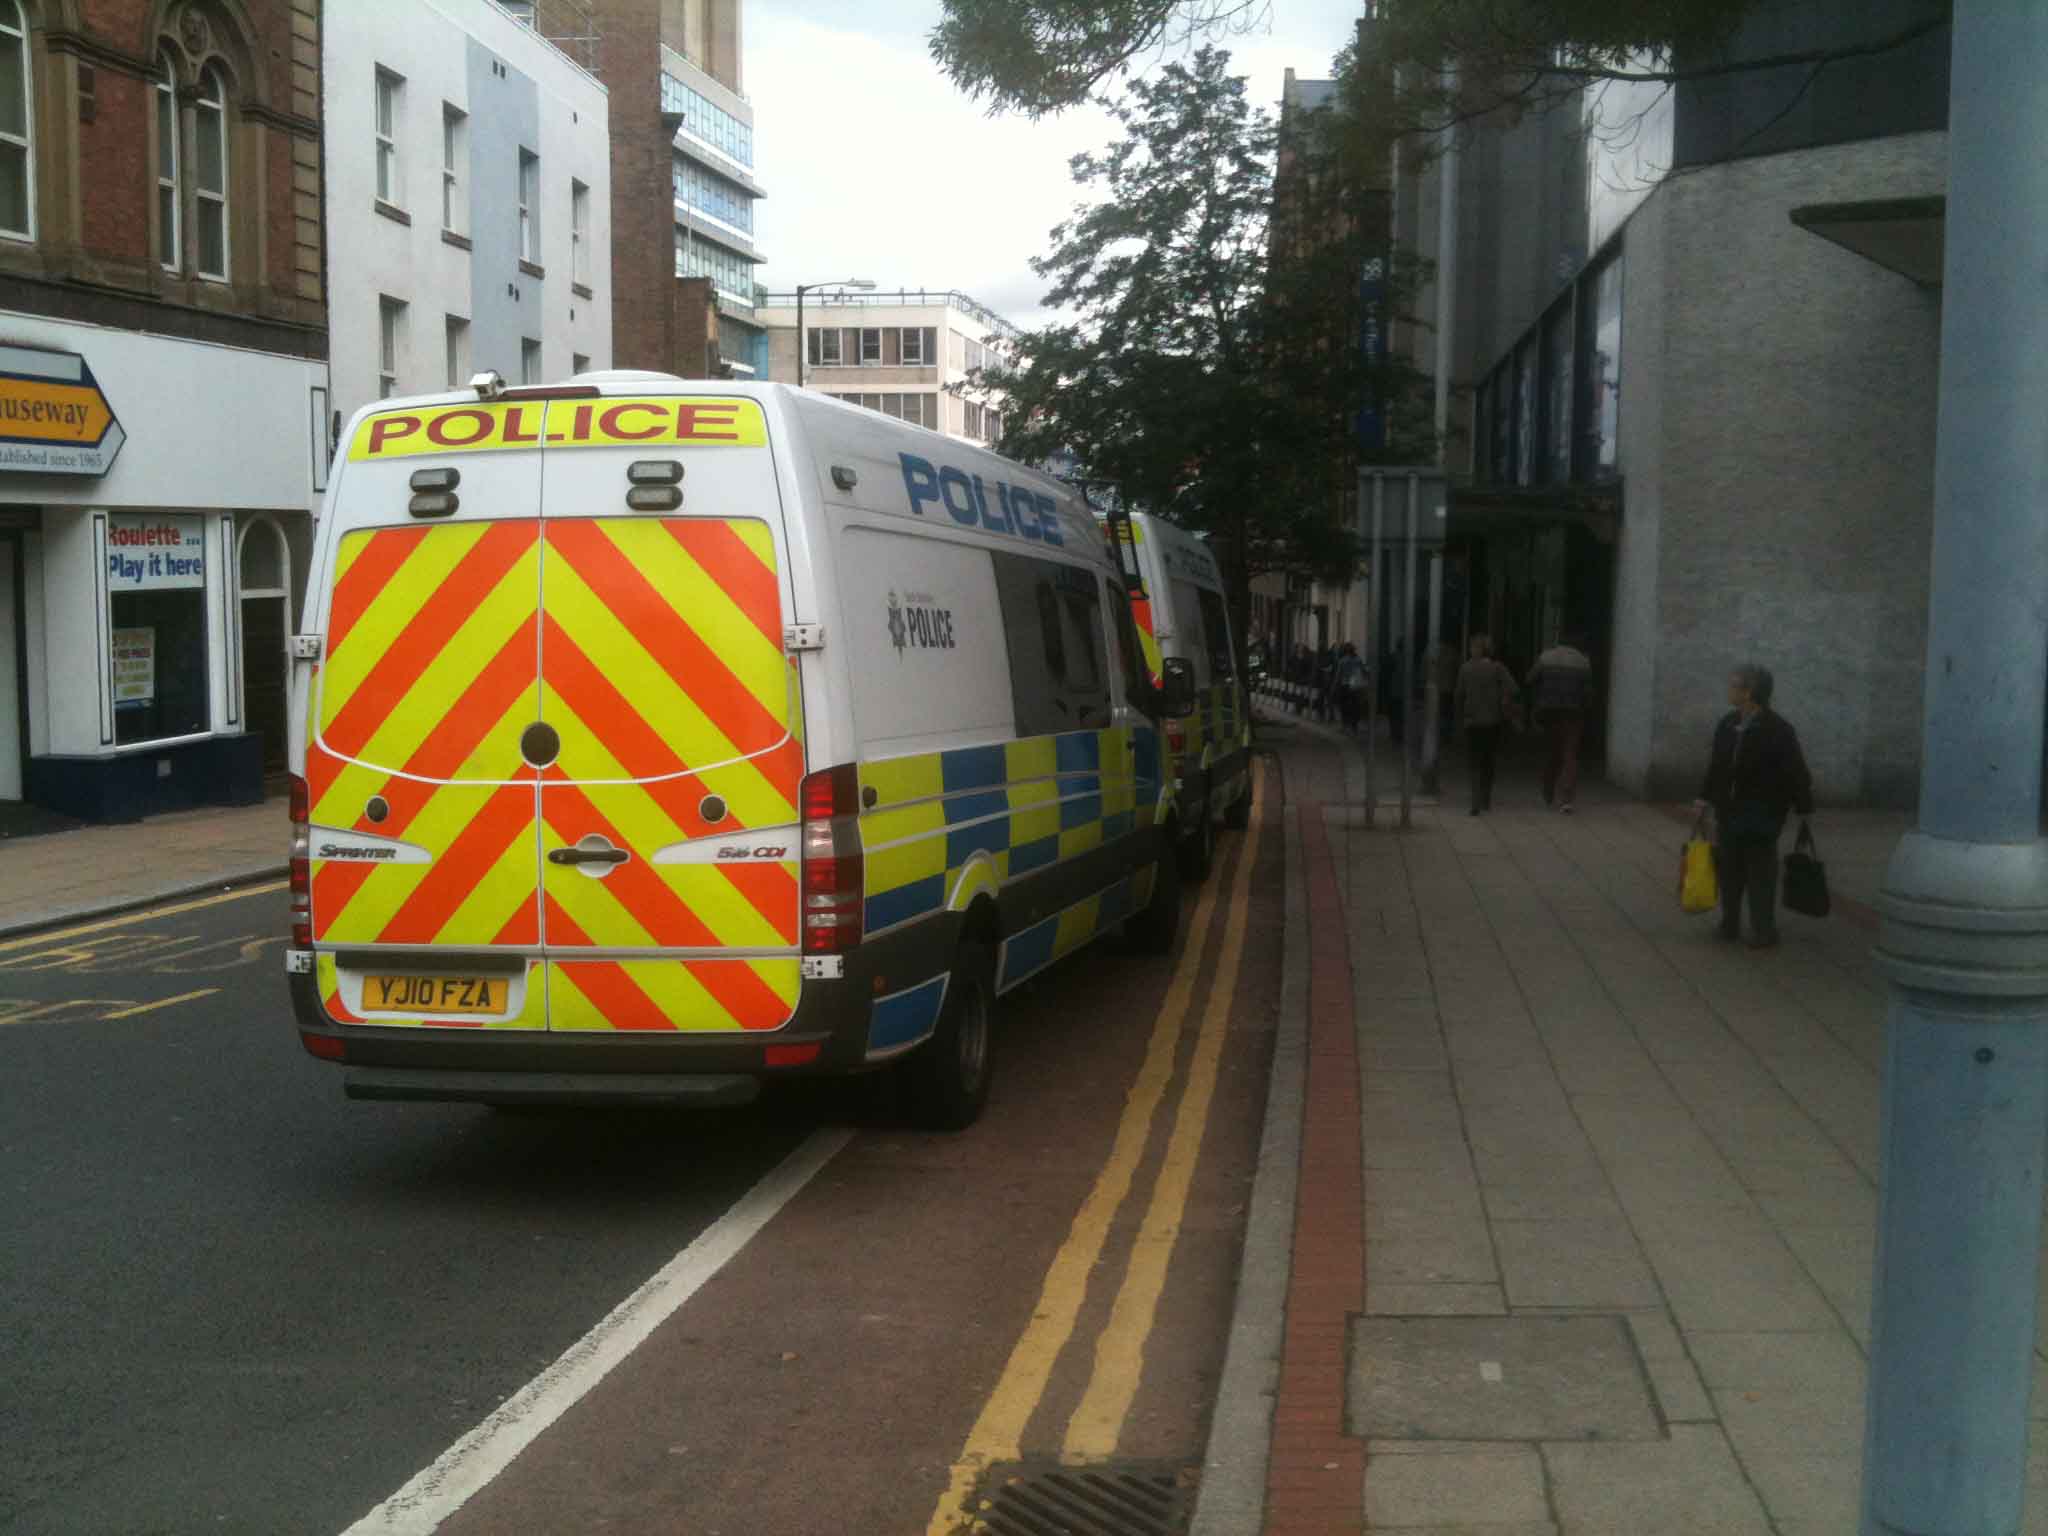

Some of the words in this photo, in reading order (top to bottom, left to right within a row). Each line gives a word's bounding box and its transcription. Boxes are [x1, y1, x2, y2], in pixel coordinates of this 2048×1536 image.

[0, 399, 88, 436] useway
[368, 403, 739, 454] POLICE
[898, 452, 1064, 546] POLICE
[109, 522, 181, 546] Roulette
[110, 553, 144, 583] Play
[149, 552, 161, 577] it
[166, 552, 202, 576] here
[907, 608, 955, 648] POLICE
[440, 979, 490, 1007] FZA
